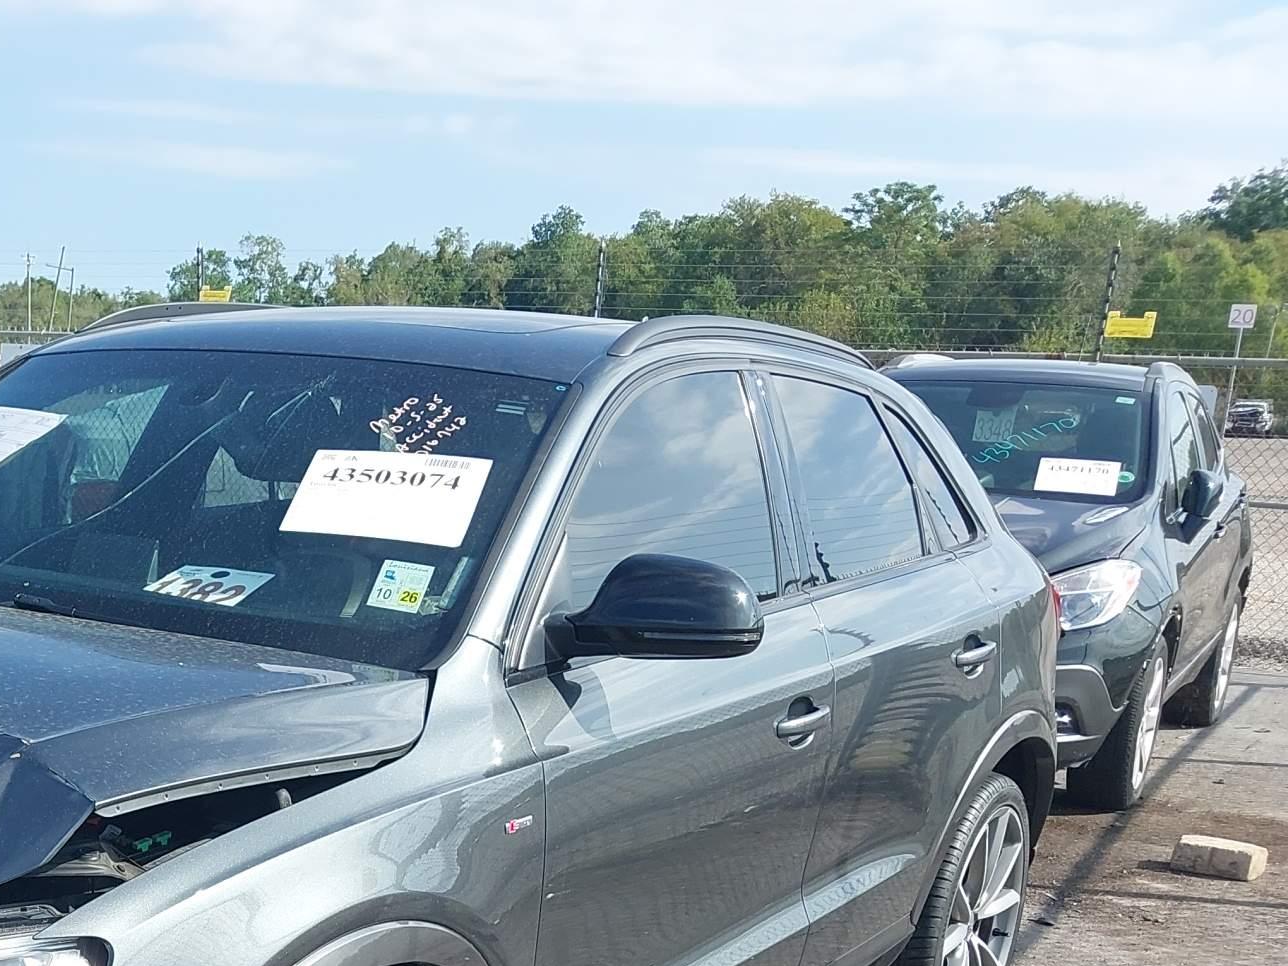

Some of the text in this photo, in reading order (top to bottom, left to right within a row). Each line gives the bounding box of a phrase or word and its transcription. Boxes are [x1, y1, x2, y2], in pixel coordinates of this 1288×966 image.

[1230, 308, 1255, 325] 20
[322, 467, 461, 490] 43503074
[376, 587, 392, 600] 10
[399, 590, 419, 604] 26
